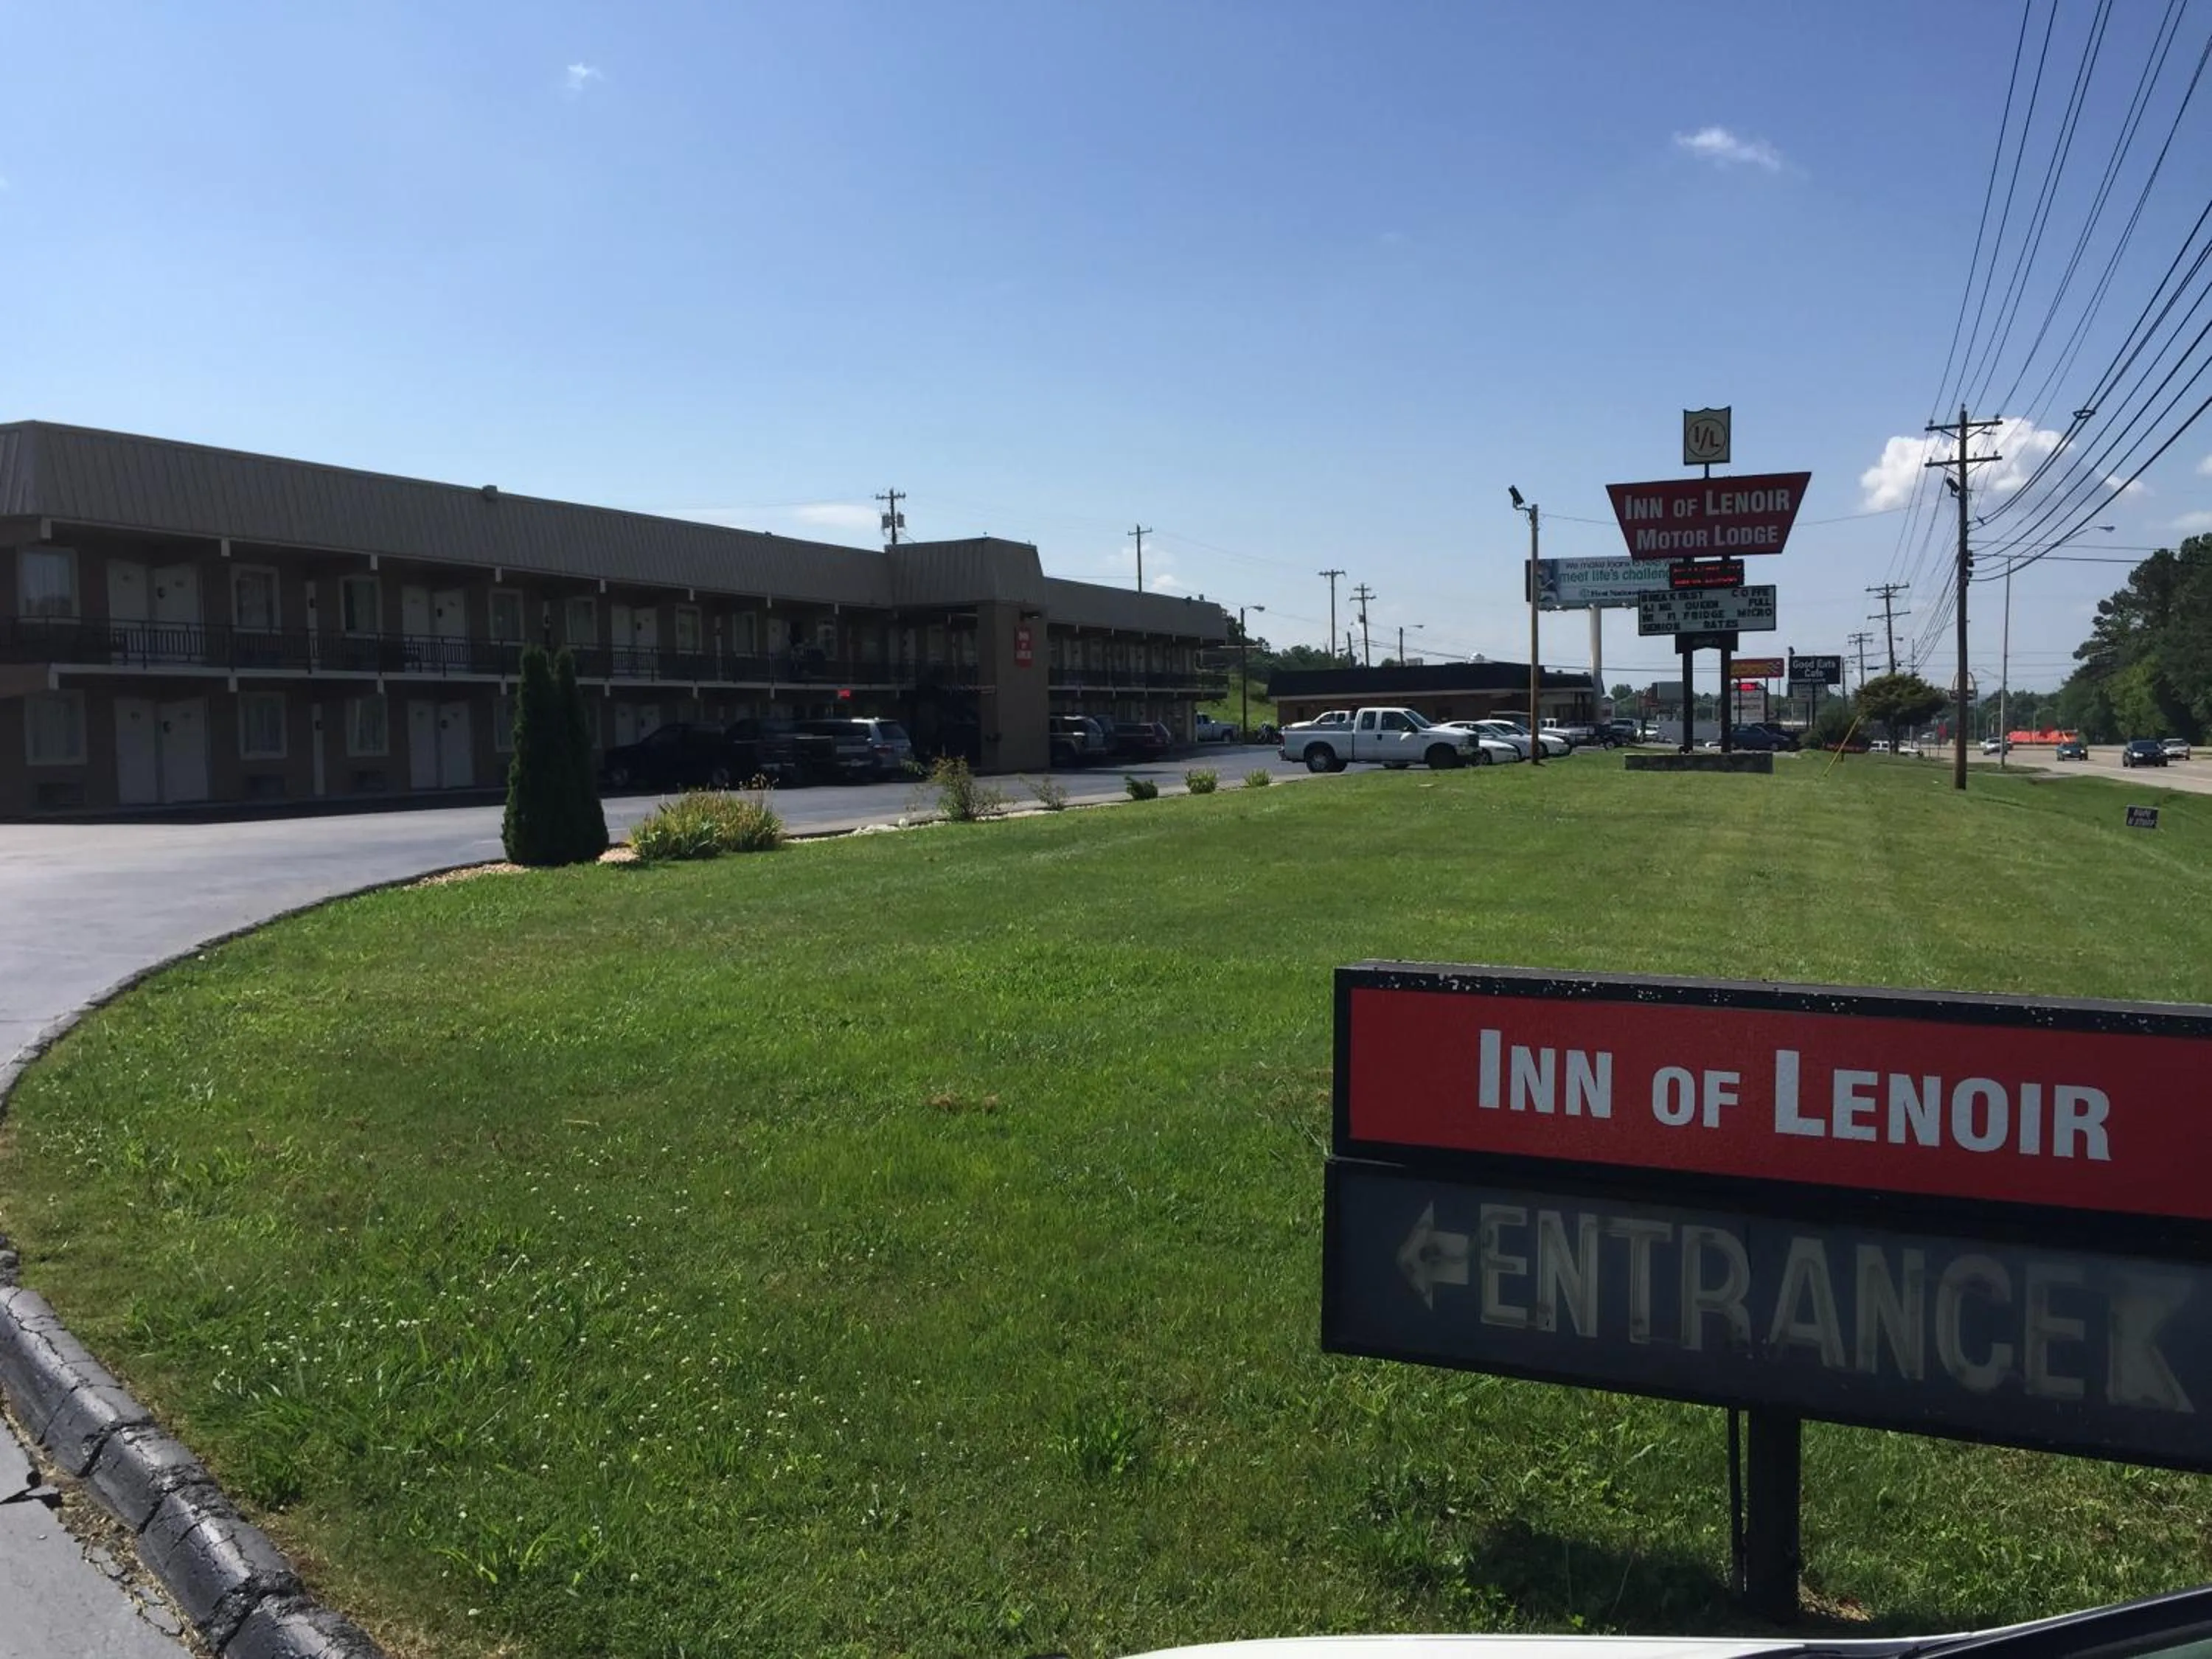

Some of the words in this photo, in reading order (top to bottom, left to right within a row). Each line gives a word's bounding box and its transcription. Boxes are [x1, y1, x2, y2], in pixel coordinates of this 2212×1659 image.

[1624, 495, 1663, 520] INN
[1673, 498, 1697, 518] OF
[1705, 489, 1790, 516] LENOIR
[1636, 529, 1708, 551] MOTOR
[1714, 524, 1778, 546] LODGE
[1559, 570, 1589, 583] meet
[1592, 568, 1619, 582] life's
[1622, 567, 1670, 581] challeng
[1684, 600, 1719, 611] QUEEN
[1748, 598, 1773, 607] FULL
[1683, 609, 1725, 620] FRIDGE
[1736, 607, 1773, 619] MICRO
[1642, 622, 1680, 632] SENIOR
[1792, 658, 1815, 669] Good
[1478, 1028, 1613, 1119] INN
[1652, 1065, 1741, 1129] OF
[1774, 1048, 2112, 1162] LENOIR
[1479, 1202, 2085, 1400] ENTRANCE
